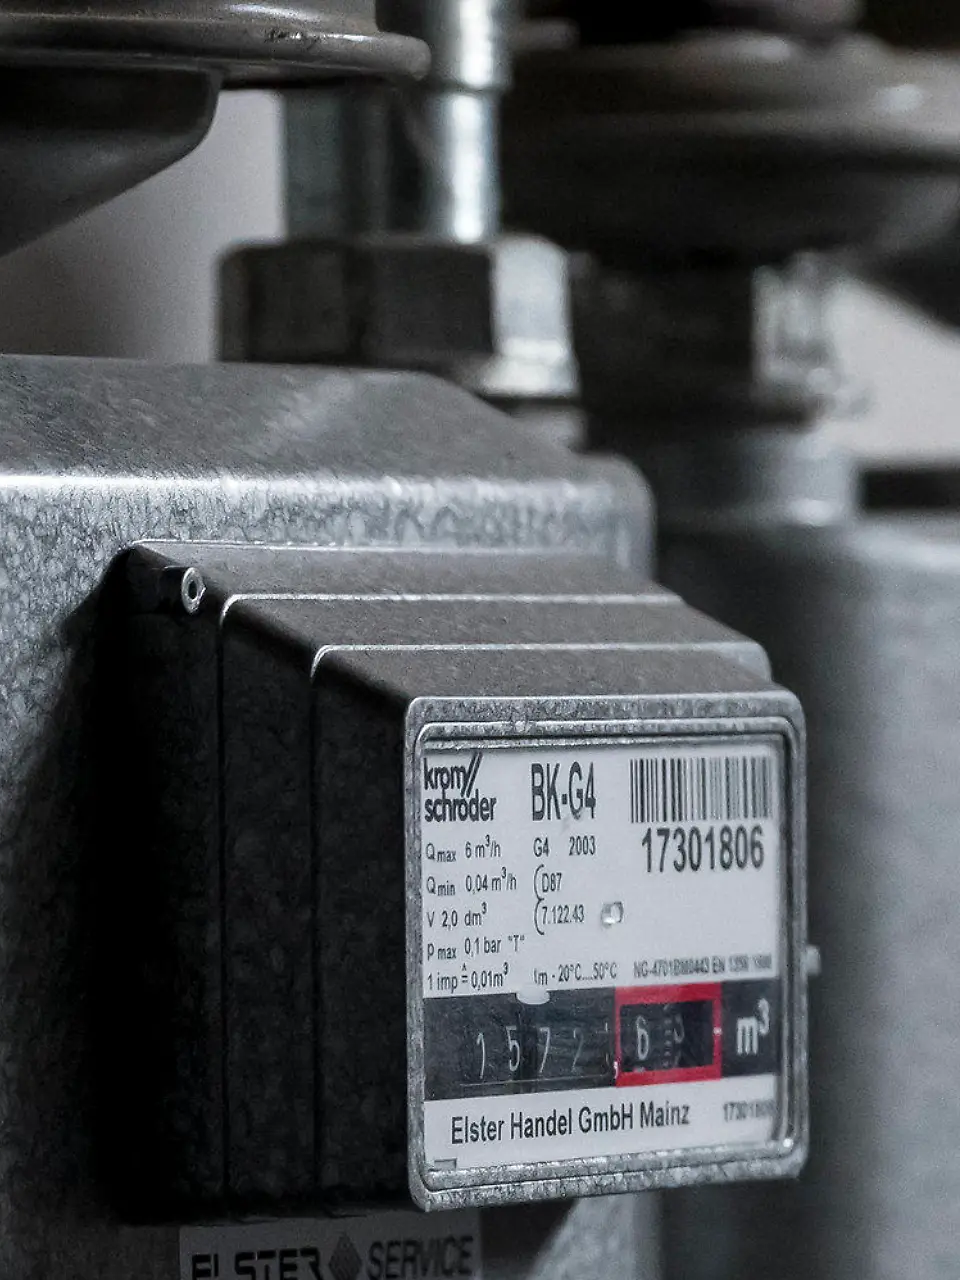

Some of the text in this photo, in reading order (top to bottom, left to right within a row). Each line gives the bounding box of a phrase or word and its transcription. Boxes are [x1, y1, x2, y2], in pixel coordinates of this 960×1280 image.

[531, 762, 596, 821] BK-G4
[465, 841, 472, 859] 6
[533, 837, 549, 857] G4
[569, 835, 596, 856] 2003
[641, 824, 765, 873] 17301806
[465, 874, 488, 895] 0,04
[427, 911, 435, 928] V
[442, 910, 458, 930] 2,0
[483, 936, 501, 954] bar
[437, 972, 458, 994] imp
[451, 1100, 690, 1145] Elster Handel GmbH Mainz
